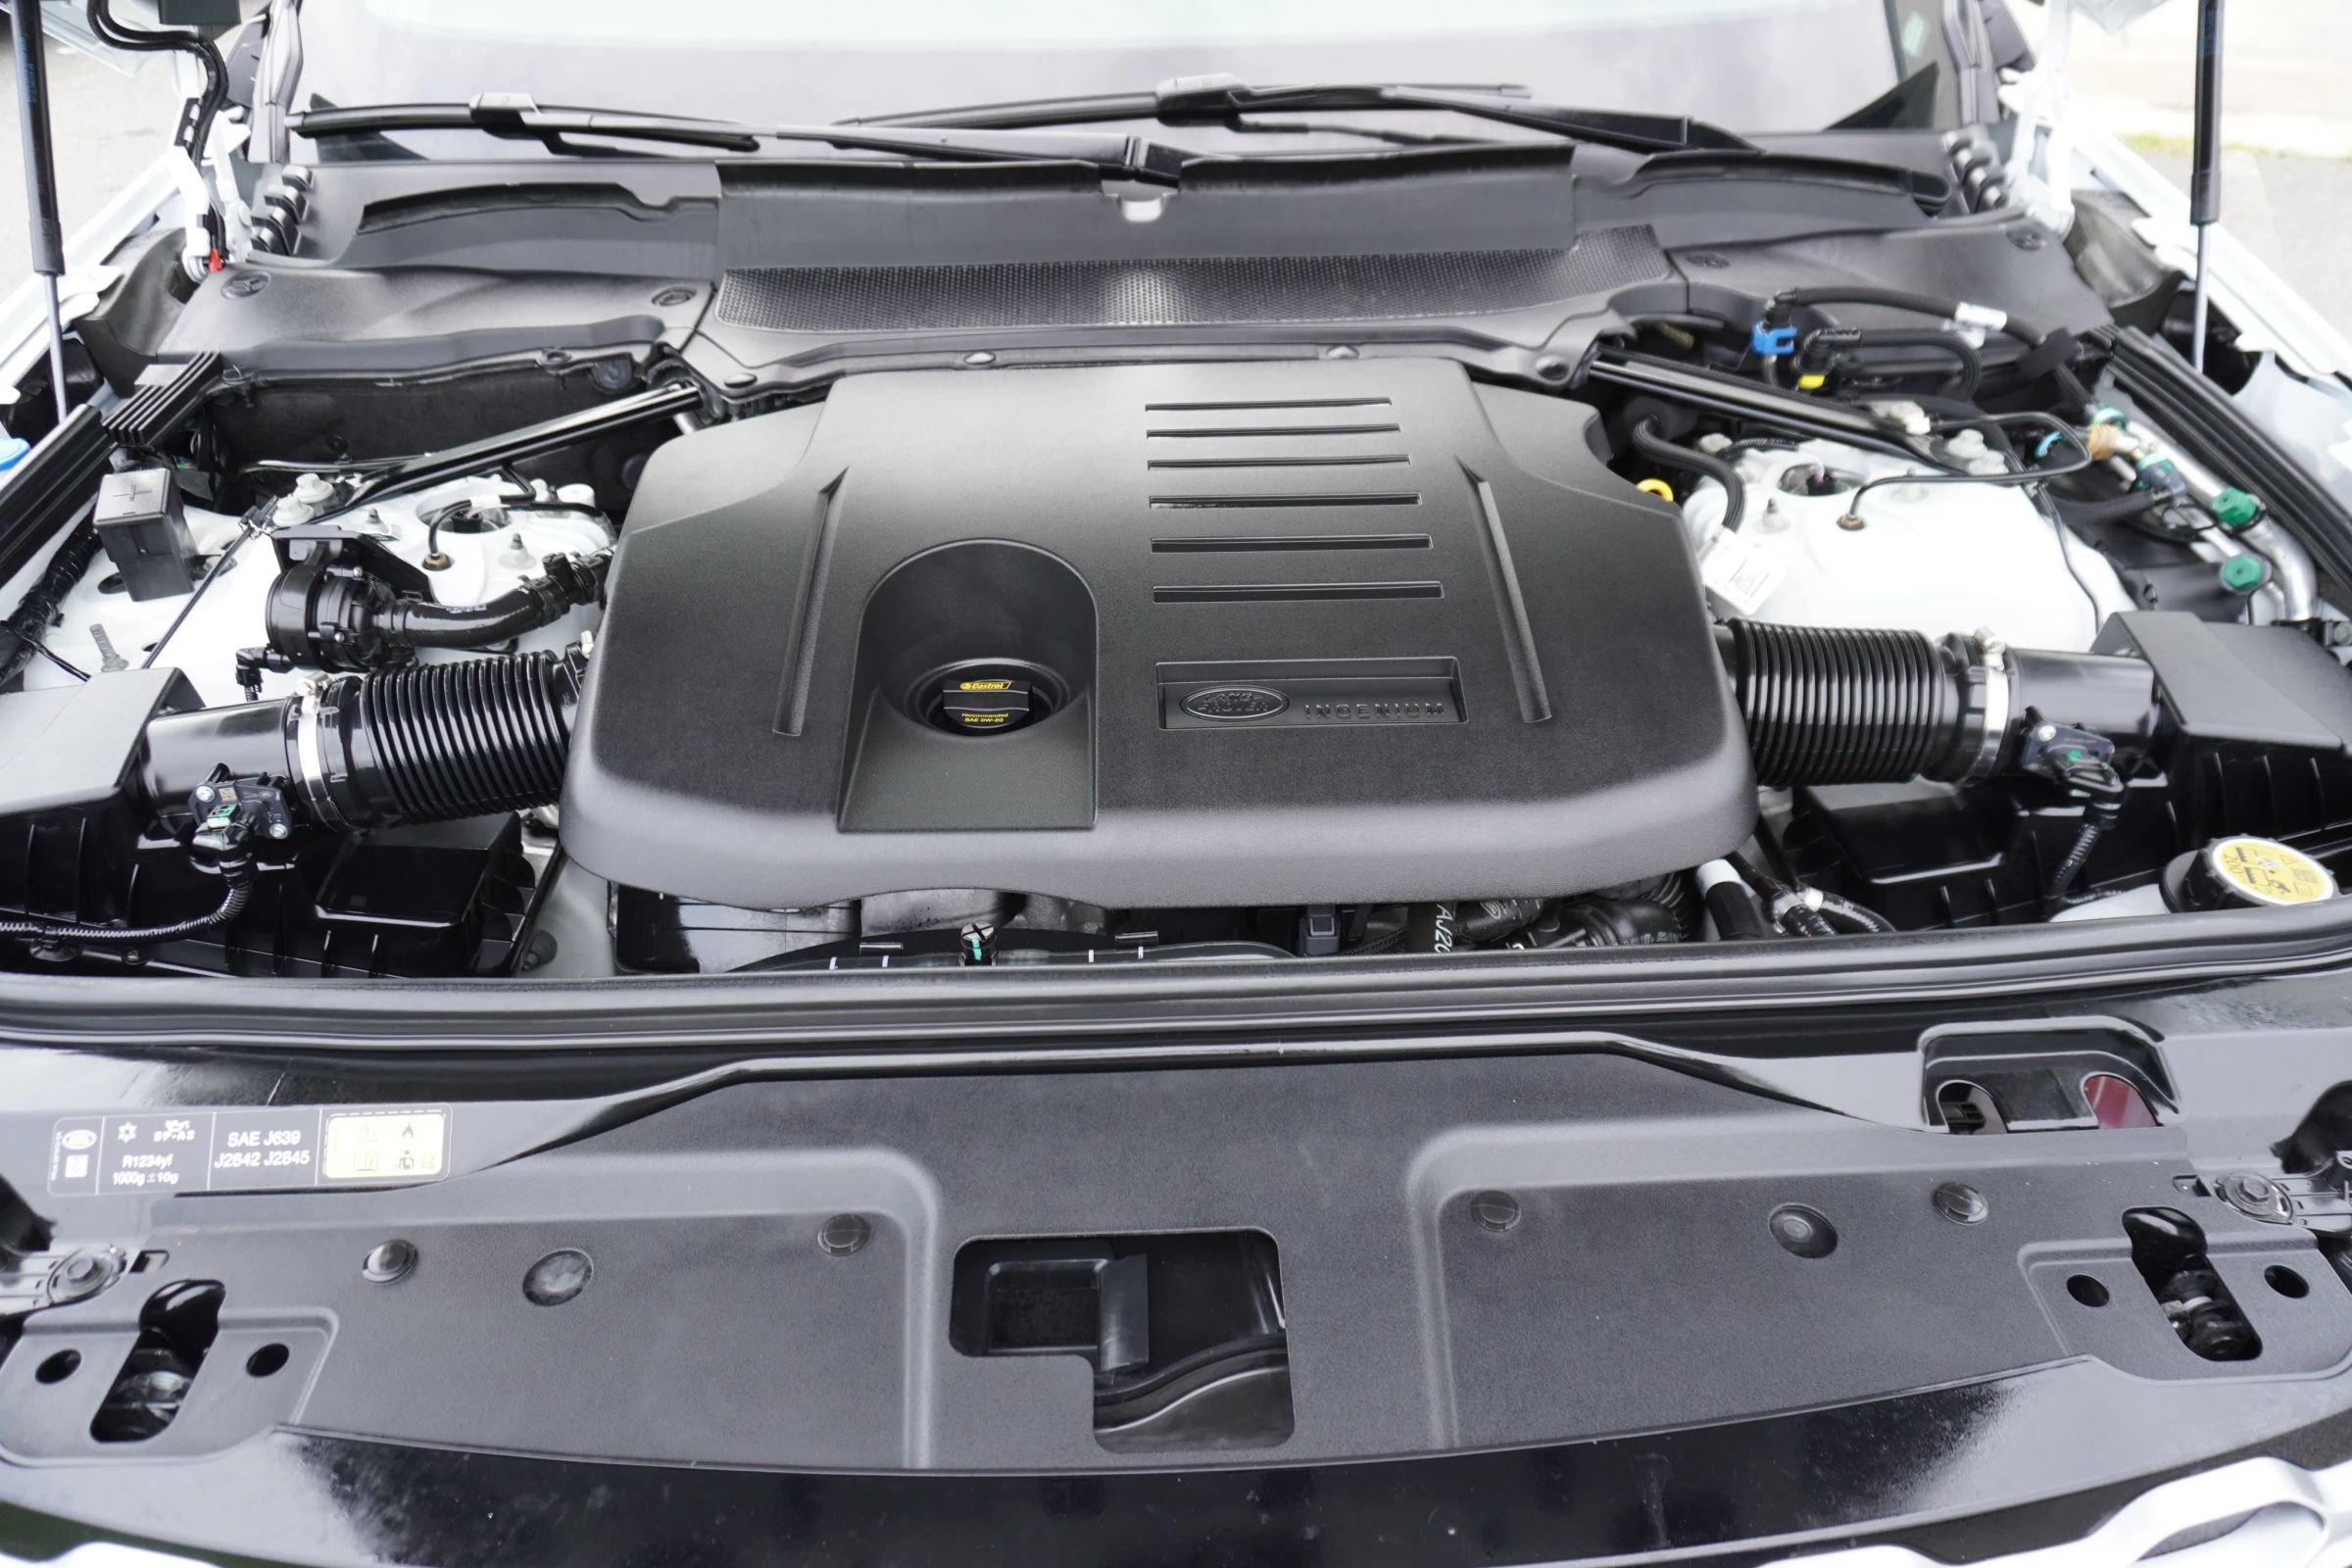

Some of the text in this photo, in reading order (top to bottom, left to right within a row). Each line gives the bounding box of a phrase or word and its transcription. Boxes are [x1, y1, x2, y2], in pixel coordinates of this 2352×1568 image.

[1304, 702, 1446, 719] INGENIUM
[226, 1130, 302, 1148] SAE J639
[214, 1150, 311, 1168] J2842 J2845
